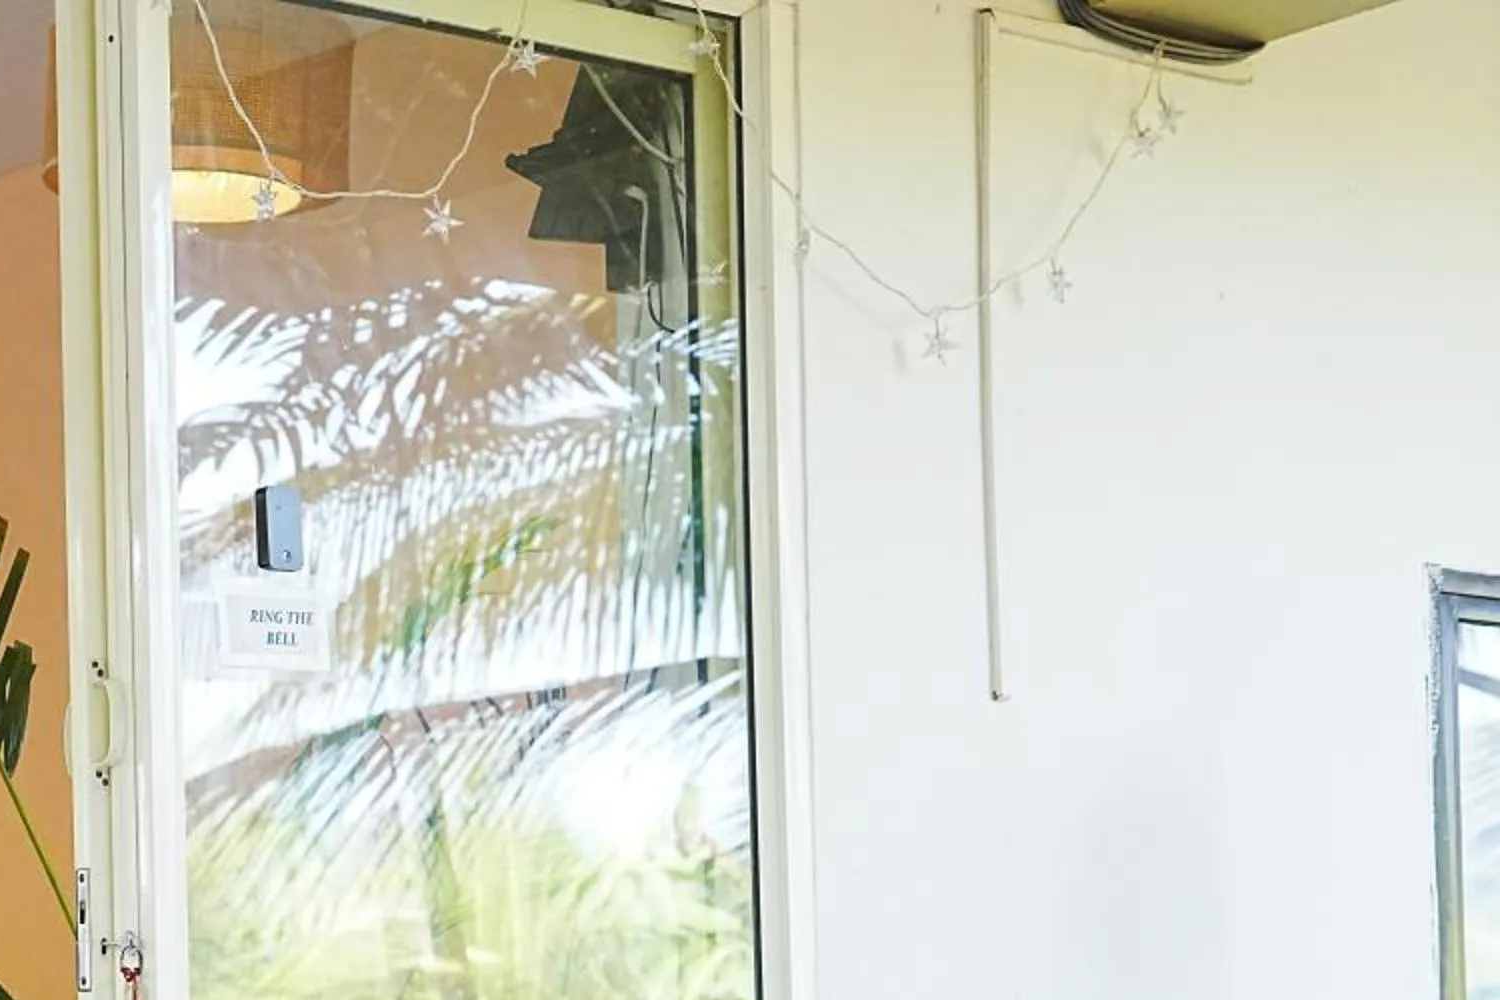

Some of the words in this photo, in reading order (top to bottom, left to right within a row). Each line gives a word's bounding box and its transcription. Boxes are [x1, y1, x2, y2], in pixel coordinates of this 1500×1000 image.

[249, 608, 283, 624] RING
[287, 610, 315, 626] THE
[266, 631, 298, 647] BELL
